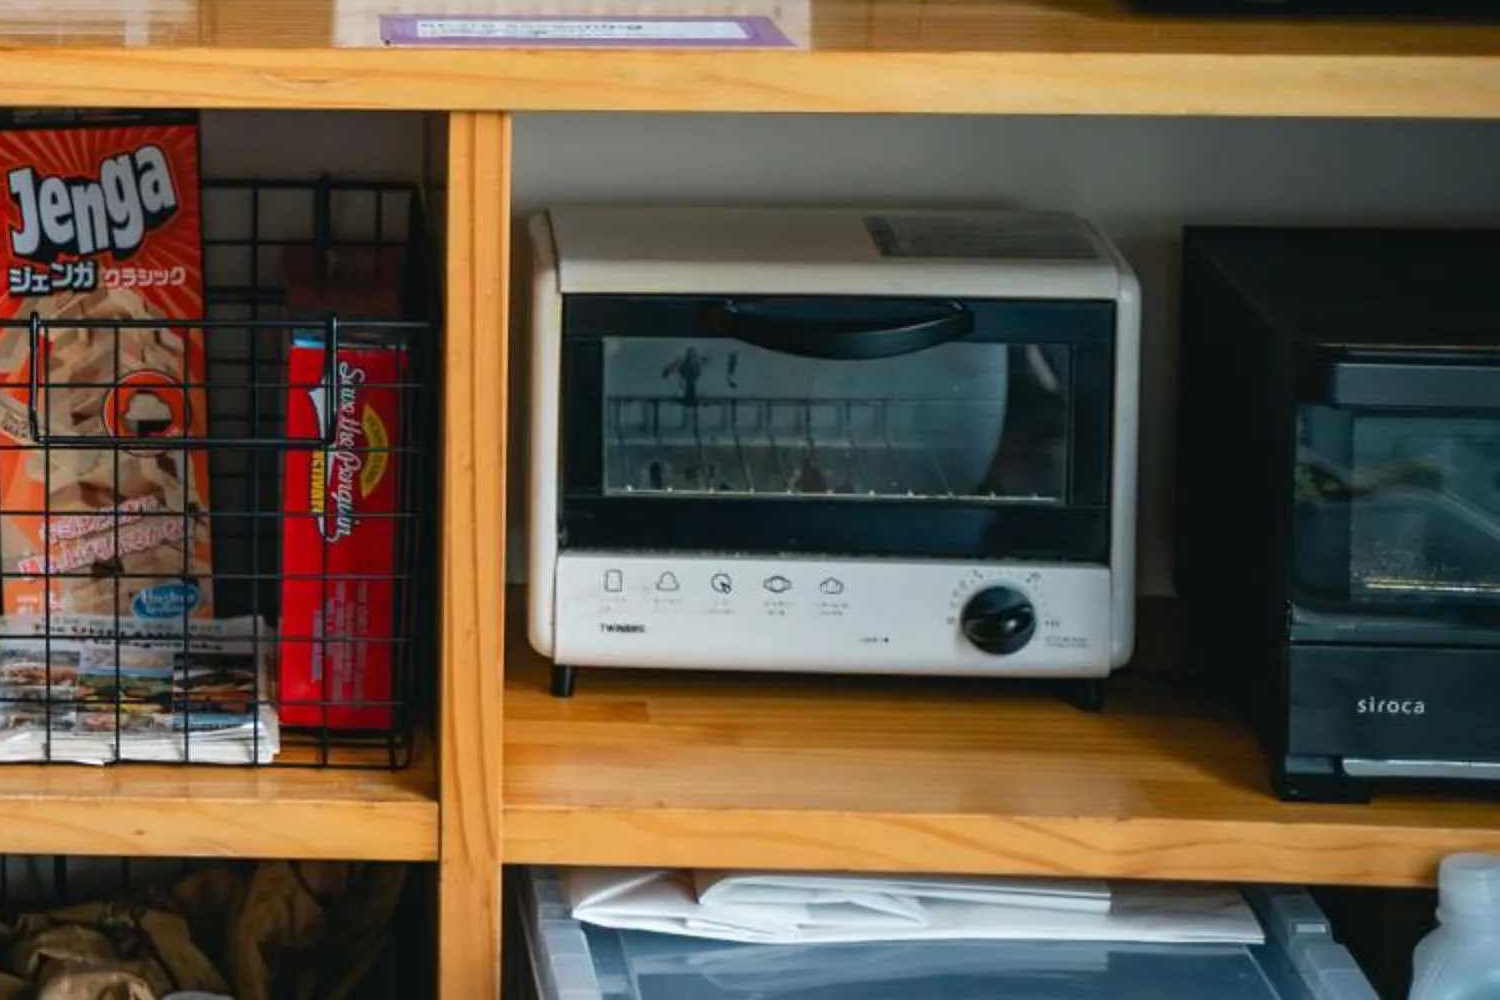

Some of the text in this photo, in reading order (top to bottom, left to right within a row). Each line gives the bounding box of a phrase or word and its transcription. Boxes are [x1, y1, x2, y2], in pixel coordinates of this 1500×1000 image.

[8, 144, 177, 257] Jenga
[9, 261, 186, 293] ジェンガ クラシック
[329, 361, 365, 540] Save the Penguin
[1357, 696, 1426, 715] siroca
